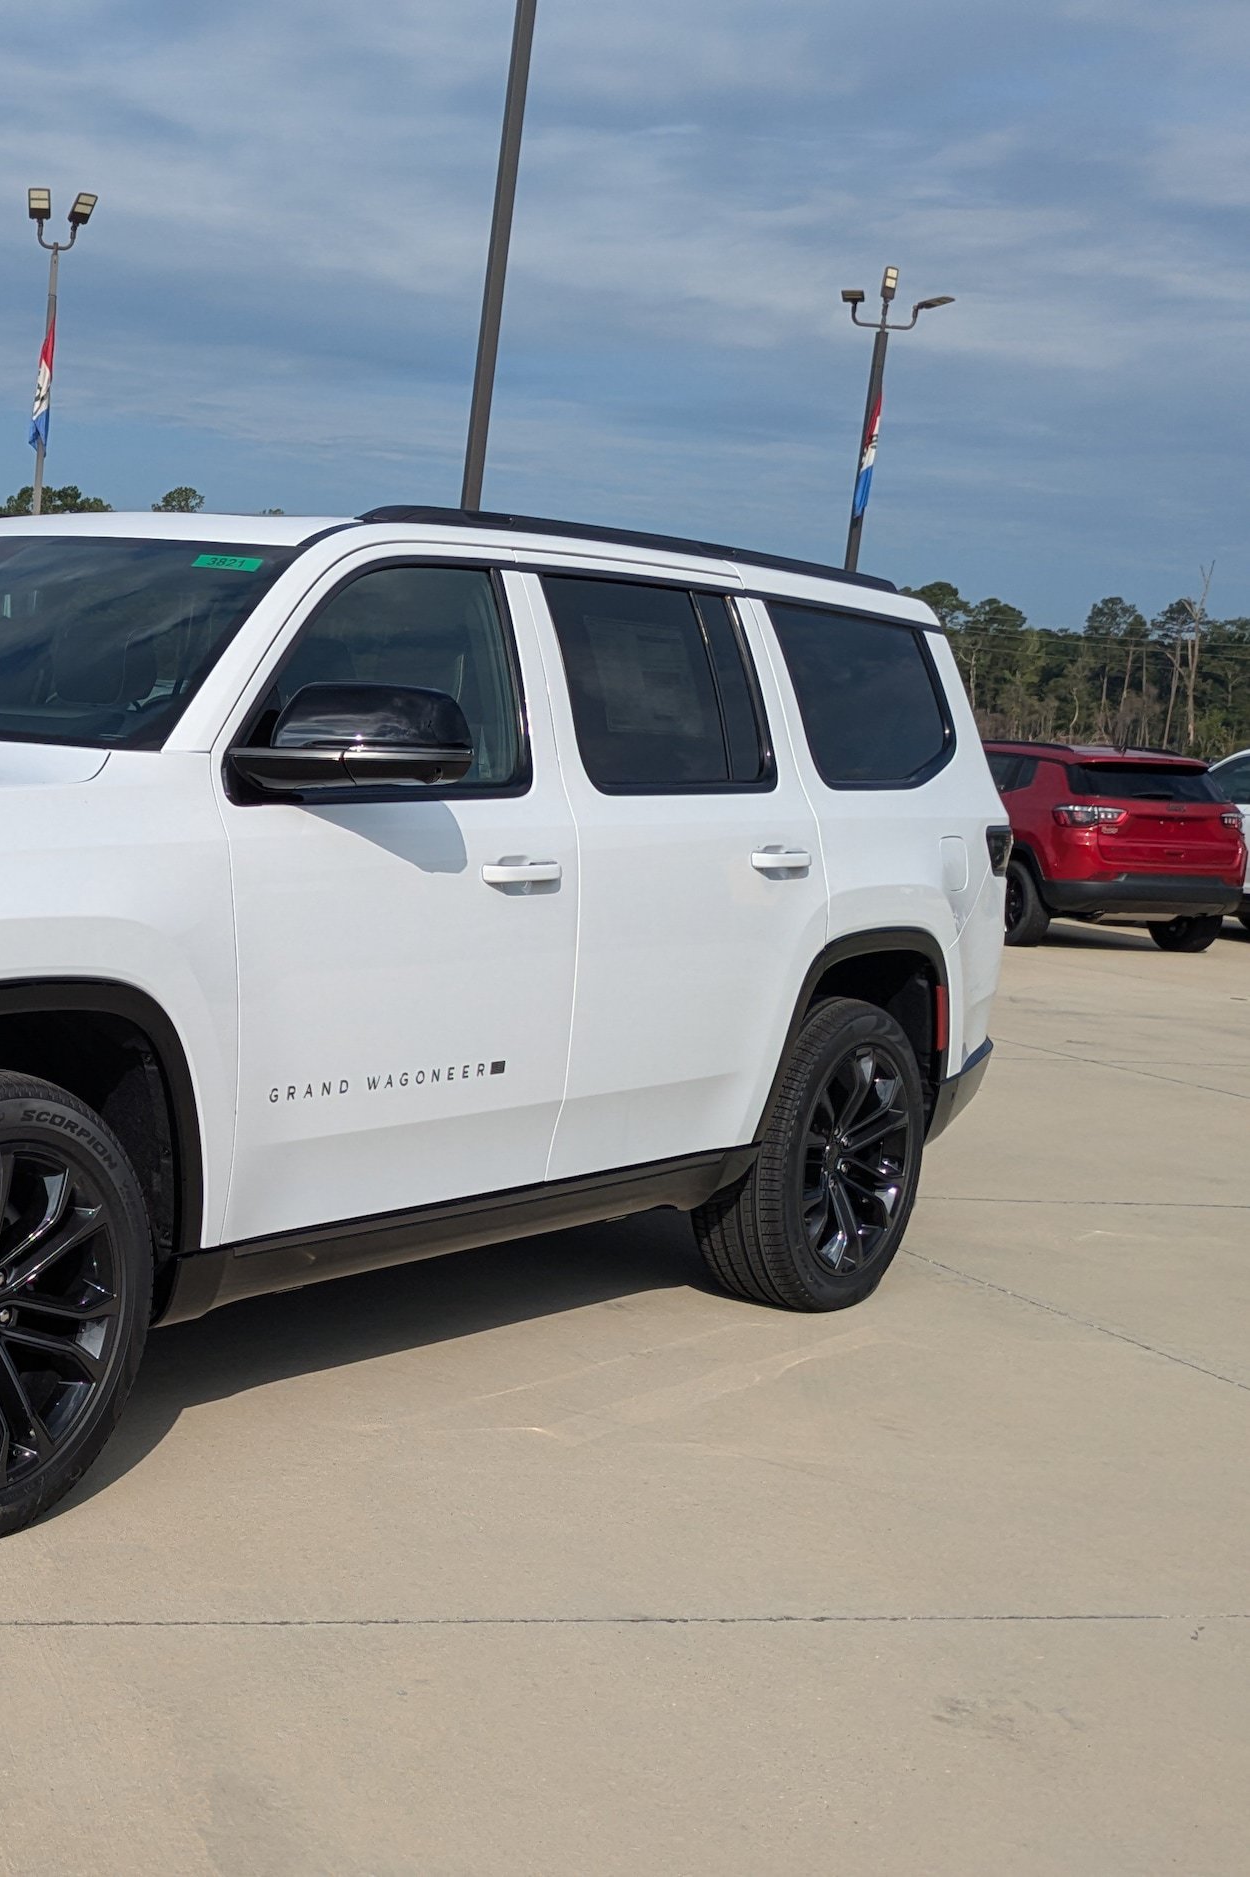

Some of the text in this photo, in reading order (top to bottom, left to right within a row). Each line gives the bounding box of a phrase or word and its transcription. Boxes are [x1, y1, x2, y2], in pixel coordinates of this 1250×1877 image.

[207, 557, 245, 567] 3821
[269, 1063, 486, 1103] GRAND WAGONEER
[20, 1109, 117, 1170] SCORPION
